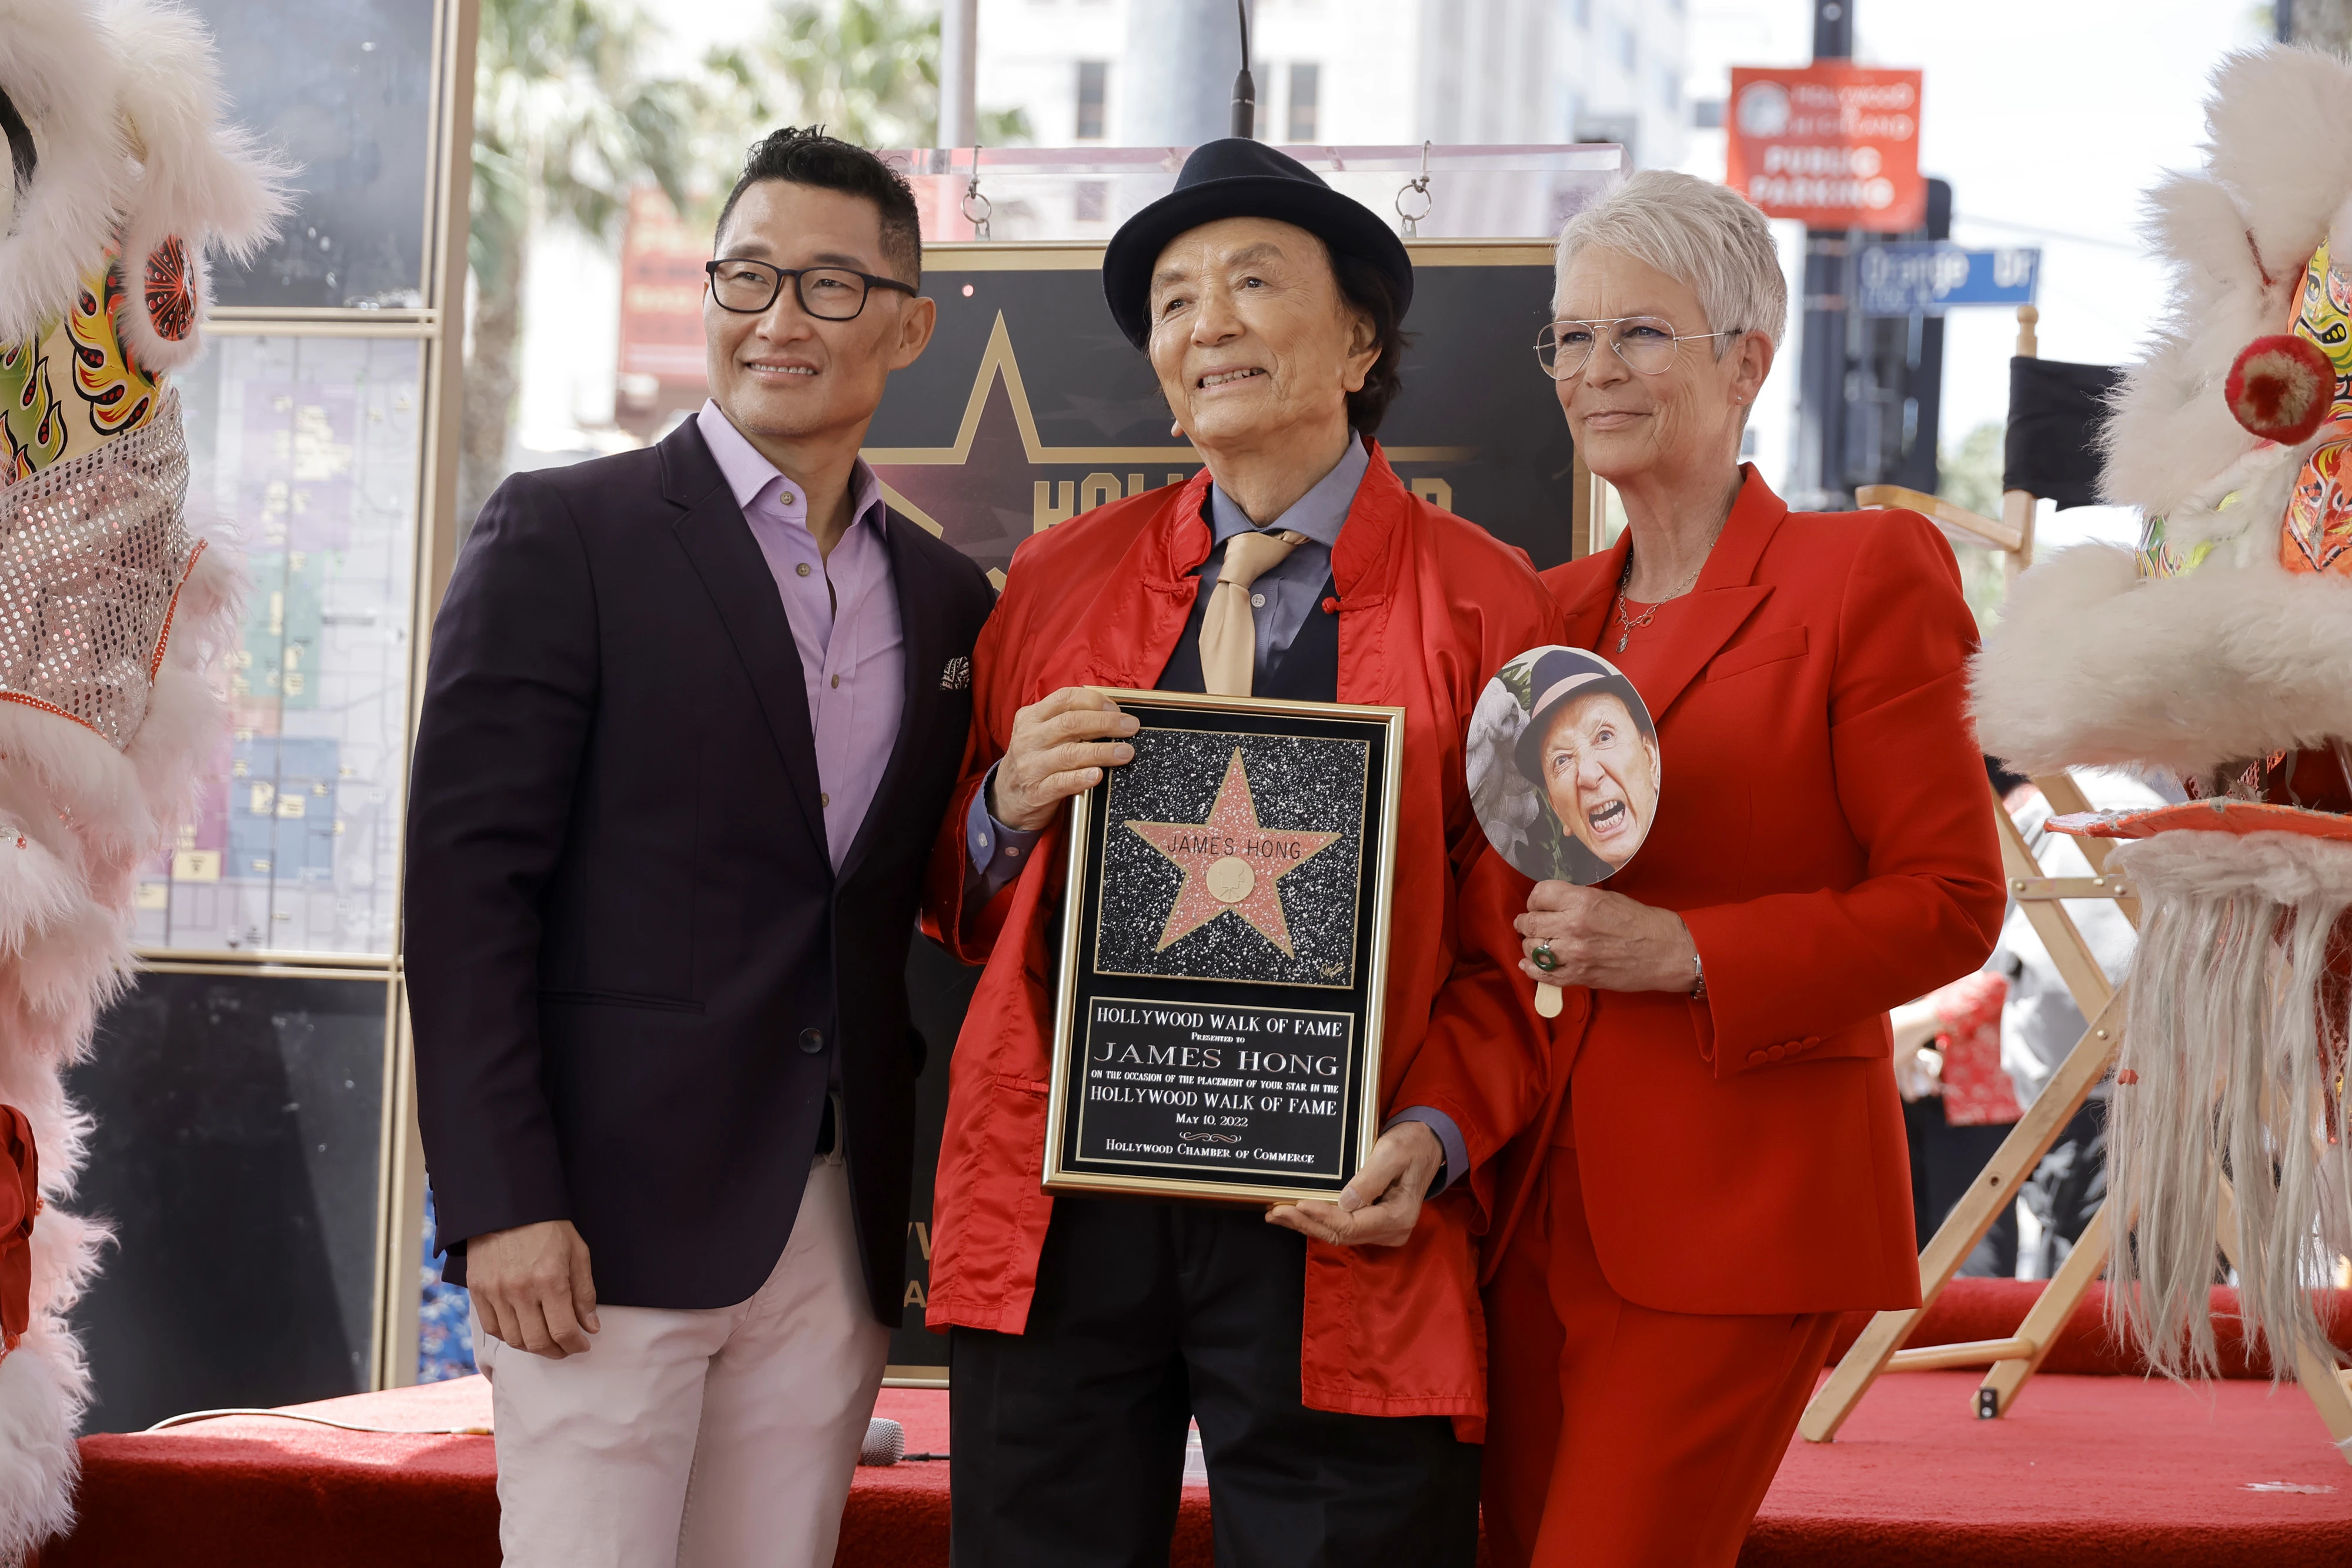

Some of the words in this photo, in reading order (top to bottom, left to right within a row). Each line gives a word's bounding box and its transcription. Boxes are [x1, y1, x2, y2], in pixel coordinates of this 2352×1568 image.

[1168, 835, 1234, 855] JAMES
[1247, 839, 1301, 860] HONG
[1097, 1007, 1204, 1028] HOLLYWOOD
[1210, 1014, 1261, 1032] WALK
[1267, 1018, 1288, 1033] OF
[1294, 1019, 1342, 1037] FAME
[1094, 1042, 1221, 1068] JAMES
[1237, 1050, 1339, 1075] HONG
[1091, 1069, 1103, 1079] ON
[1106, 1071, 1122, 1080] THE
[1124, 1071, 1162, 1082] OCCASION
[1165, 1074, 1176, 1083] OF
[1179, 1075, 1194, 1084] THE
[1197, 1076, 1244, 1088] PLACEMENT
[1246, 1079, 1257, 1088] OF
[1260, 1080, 1283, 1089] YOUR
[1286, 1082, 1307, 1092] STAR
[1310, 1084, 1320, 1092] IN
[1323, 1085, 1339, 1094] THE
[1090, 1085, 1198, 1106] HOLLYWOOD
[1204, 1092, 1254, 1111] WALK
[1261, 1096, 1282, 1112] OF
[1288, 1098, 1337, 1115] FAME
[1220, 1116, 1248, 1127] 2022
